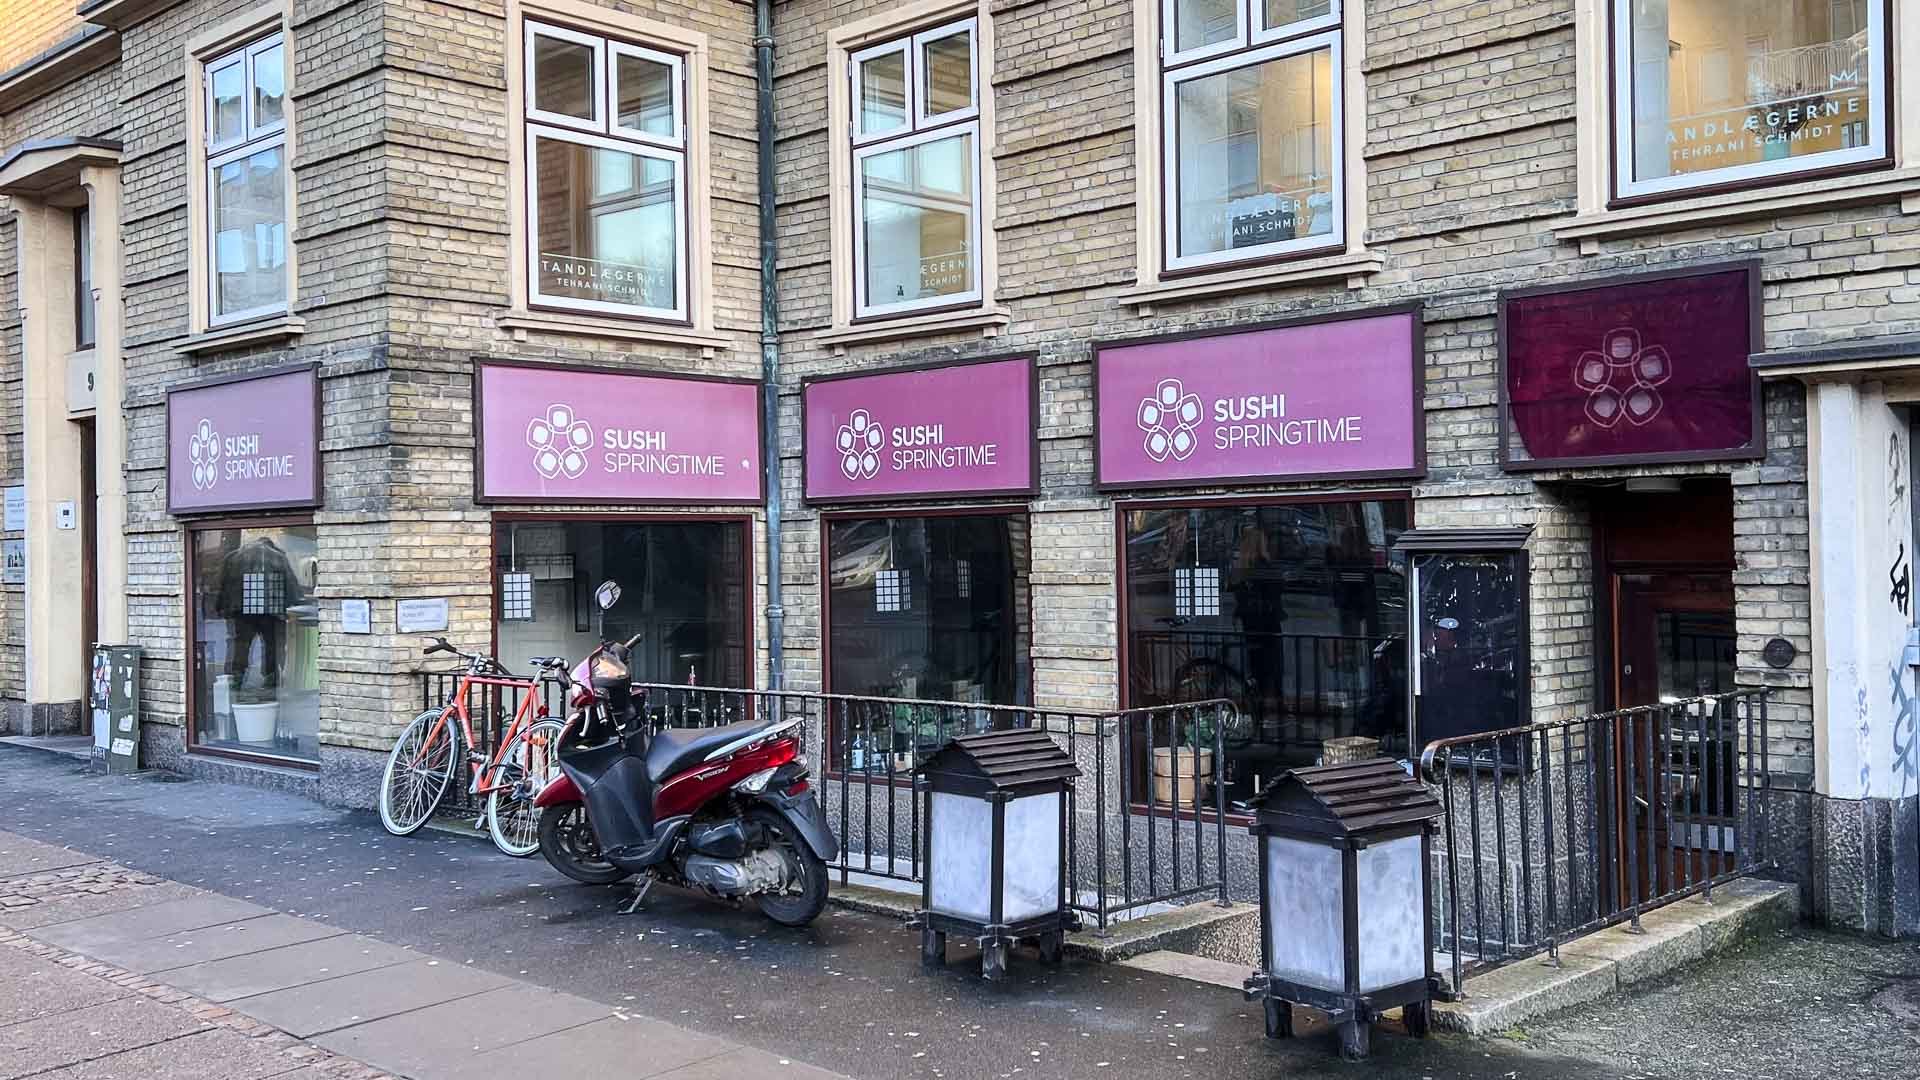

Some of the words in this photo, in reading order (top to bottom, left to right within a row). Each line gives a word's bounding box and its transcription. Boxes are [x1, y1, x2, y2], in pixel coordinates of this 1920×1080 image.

[1665, 97, 1860, 144] ANDLÆGERNE
[1672, 139, 1744, 160] TEHRANI
[1753, 124, 1833, 147] SCHMIDT
[1259, 215, 1312, 232] SCHMIDT
[541, 260, 665, 287] TANDLÆGERNE
[557, 277, 602, 290] TEHRANI
[87, 371, 95, 392] 9
[1213, 393, 1285, 422] SUSHI
[603, 428, 666, 451] SUSHI
[891, 423, 943, 447] SUSHI
[1213, 415, 1362, 450] SPRINGTIME
[224, 434, 259, 457] SUSHI
[891, 444, 997, 471] SPRINGTIME
[224, 454, 294, 481] SPRINGTIME
[603, 452, 725, 476] SPRINGTIME
